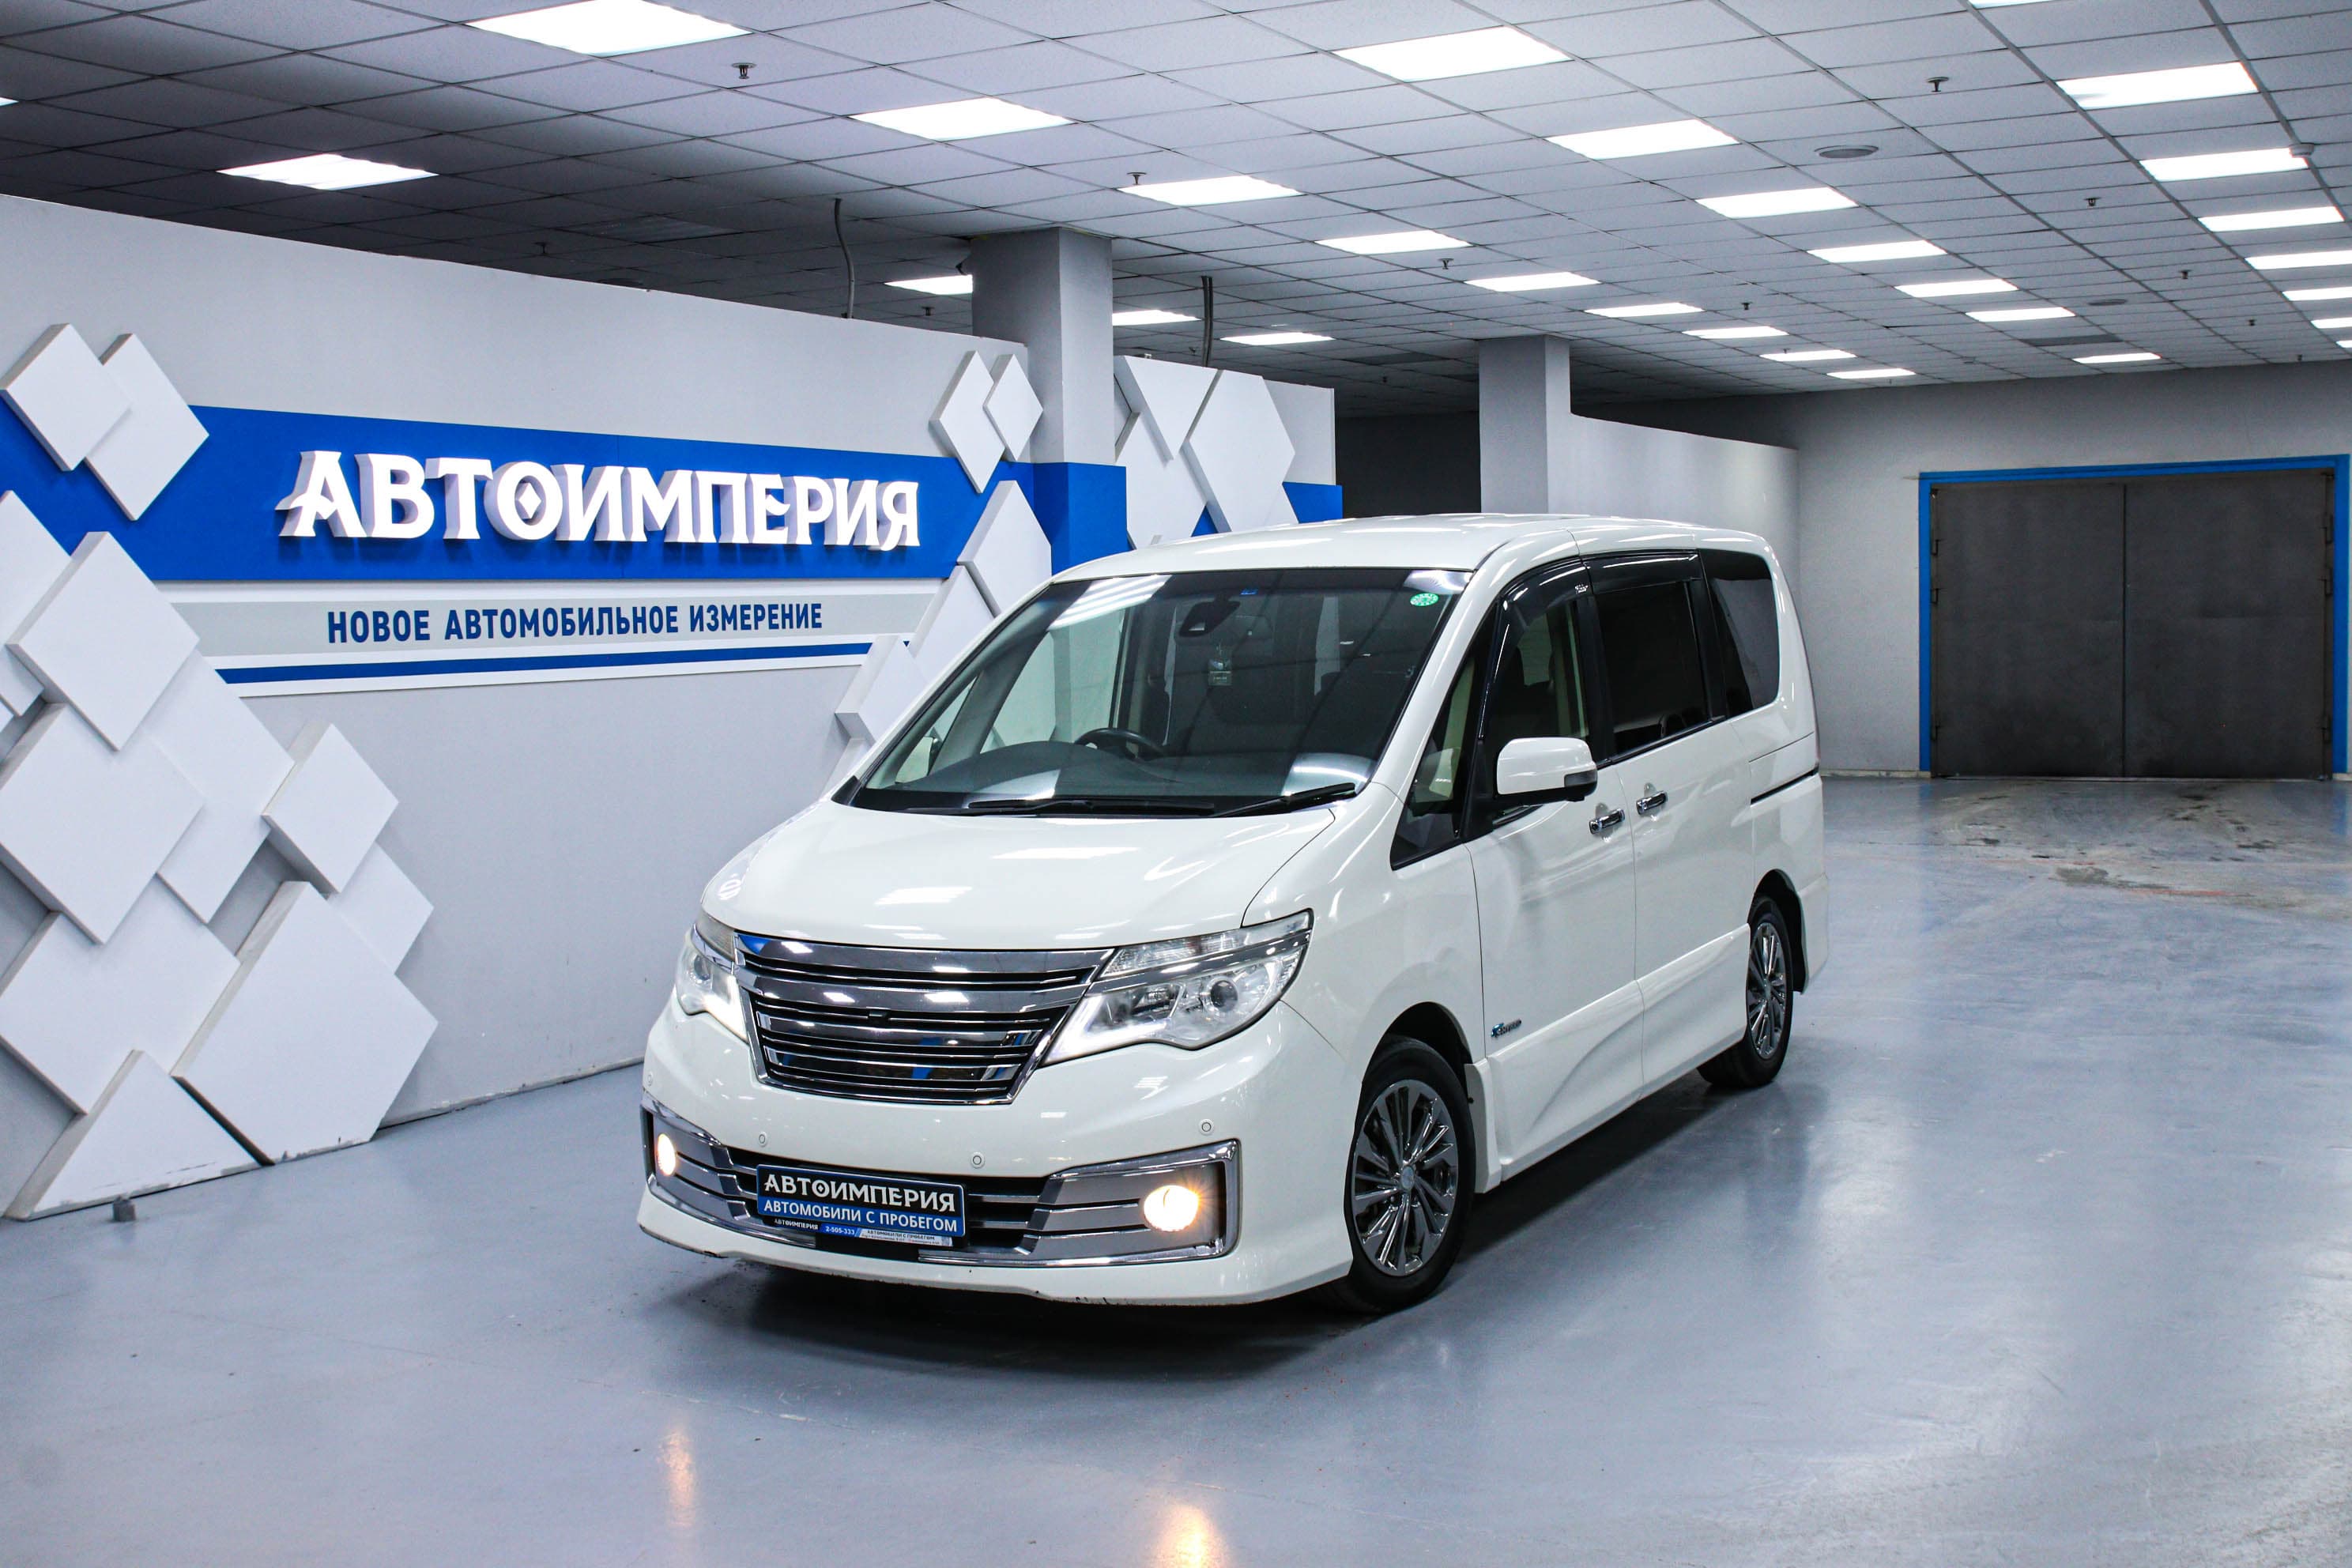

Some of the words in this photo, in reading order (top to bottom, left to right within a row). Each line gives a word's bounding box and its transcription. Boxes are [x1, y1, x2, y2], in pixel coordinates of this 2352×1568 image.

[274, 450, 919, 551] АВТОИМПЕРИЯ
[326, 605, 431, 644] НОВОЕ
[444, 605, 679, 640] АВТОМОБИЛЬНОЕ
[690, 603, 823, 631] ИЗМЕРЕНИЕ
[764, 1174, 956, 1212] АВТОИМПЕРИЯ
[763, 1199, 861, 1223] АВТОМОБИЛИ
[865, 1210, 876, 1223] С
[880, 1212, 958, 1233] ПРОБЕГОМ
[775, 1218, 819, 1231] АВТОИМПЕРИЯ
